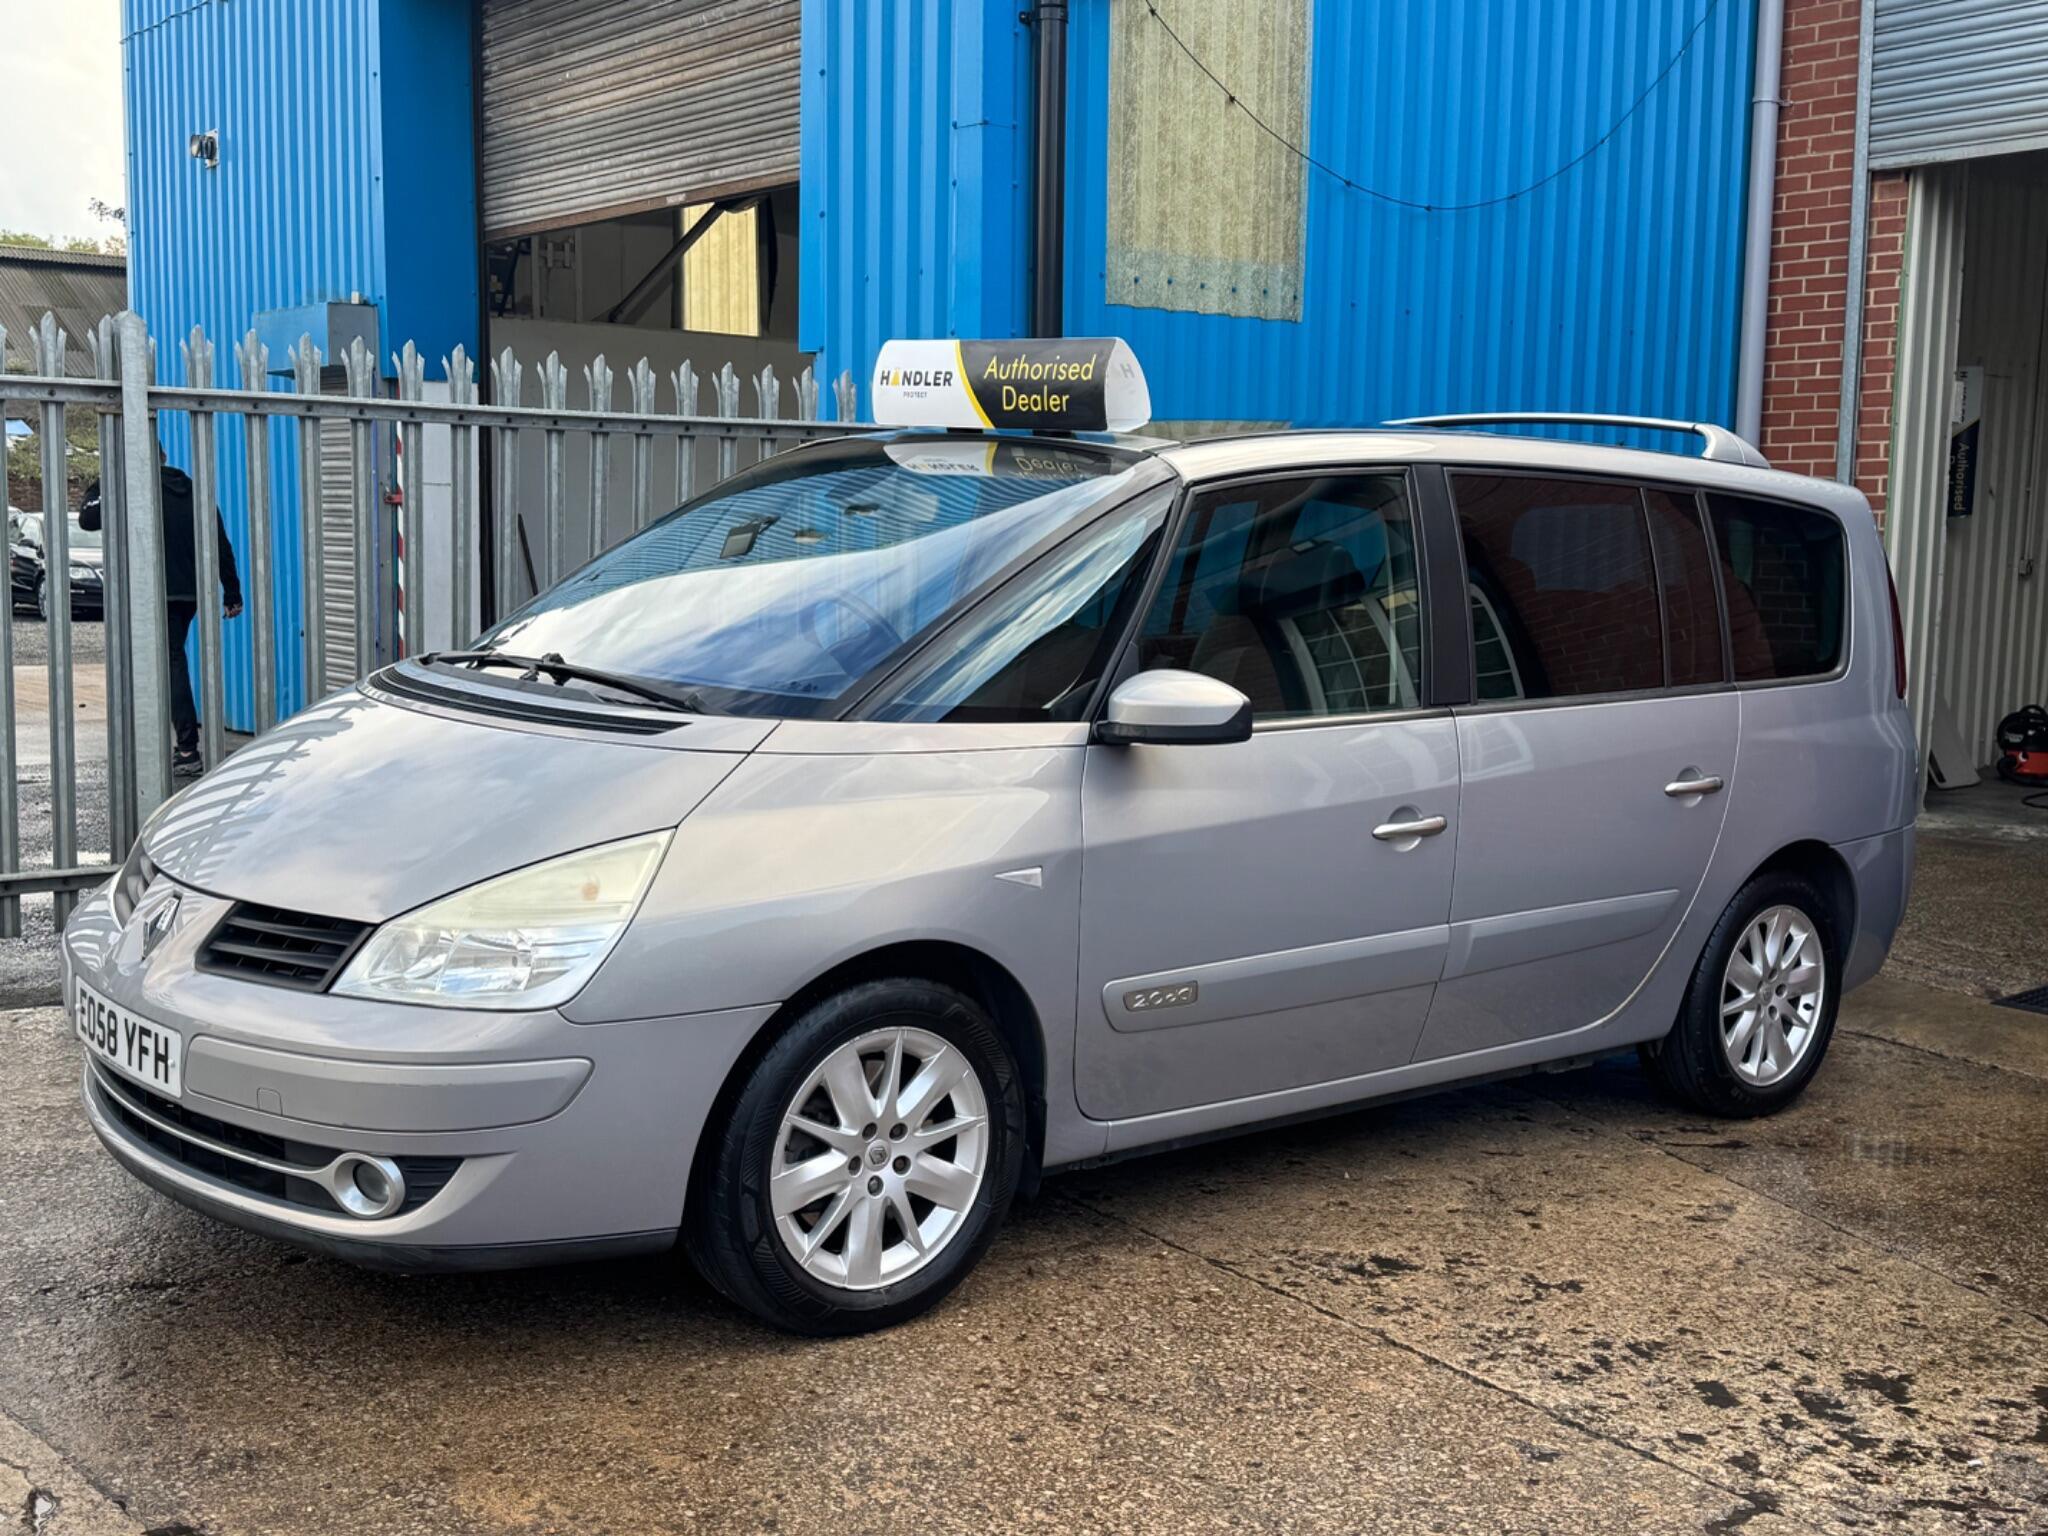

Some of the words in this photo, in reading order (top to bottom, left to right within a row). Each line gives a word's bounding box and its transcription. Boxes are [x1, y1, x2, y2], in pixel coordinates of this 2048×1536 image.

[880, 368, 953, 386] HANDLER
[983, 353, 1097, 381] Authorised
[1002, 385, 1070, 413] Dealer
[1953, 442, 1970, 512] Authorised
[80, 987, 118, 1057] EO58
[124, 1018, 169, 1084] YFH
